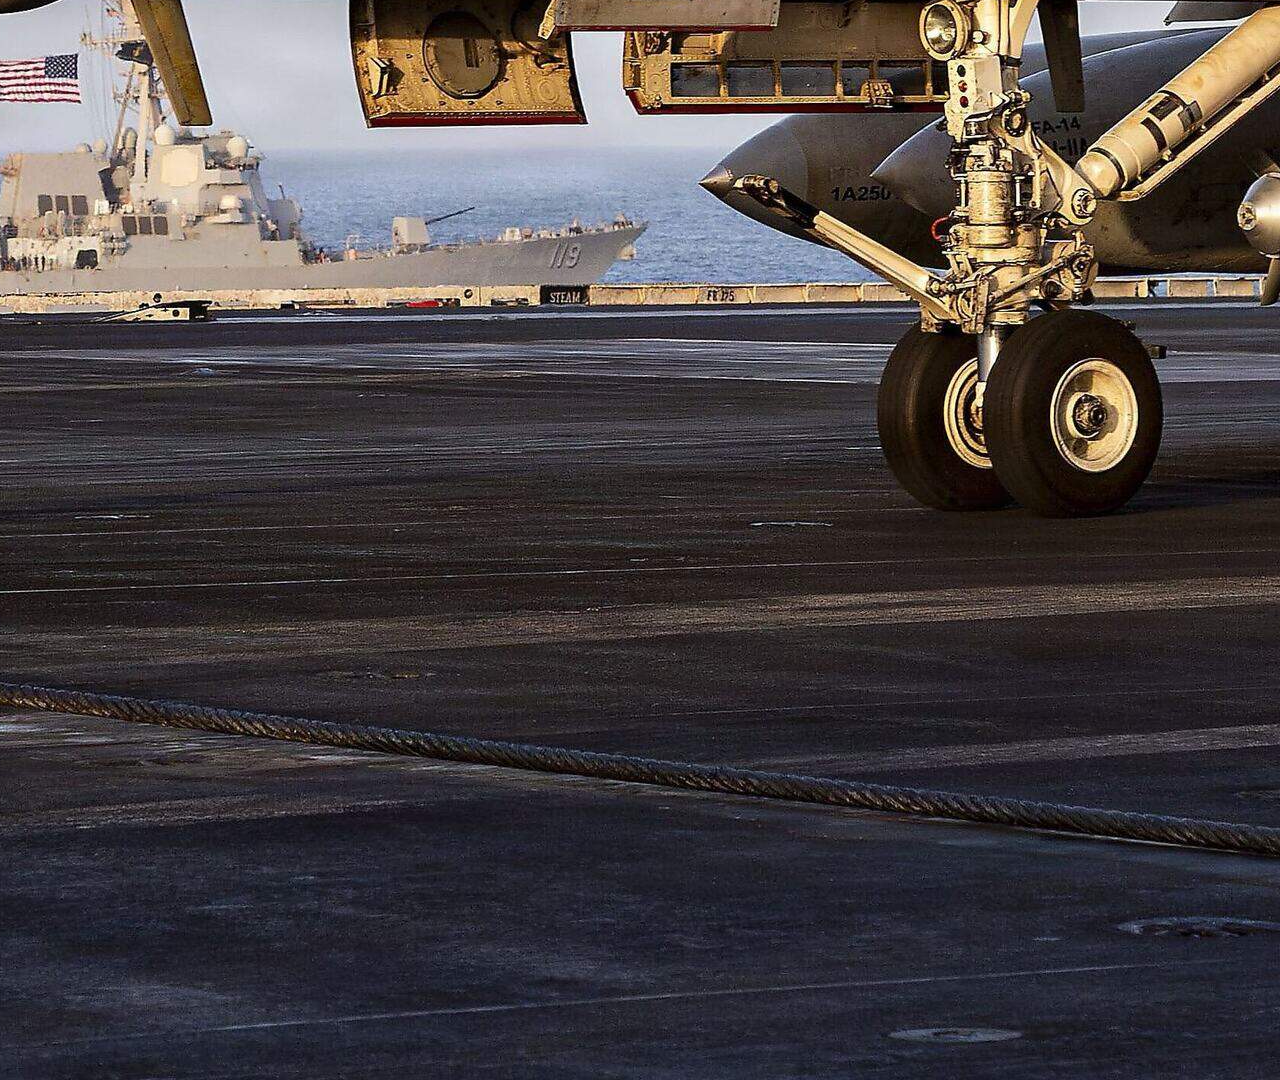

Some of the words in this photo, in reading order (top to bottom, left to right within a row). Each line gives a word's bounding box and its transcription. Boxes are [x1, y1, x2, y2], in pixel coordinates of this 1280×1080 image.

[1032, 116, 1081, 134] FA-14
[549, 241, 582, 269] 119
[549, 291, 581, 304] STEAM
